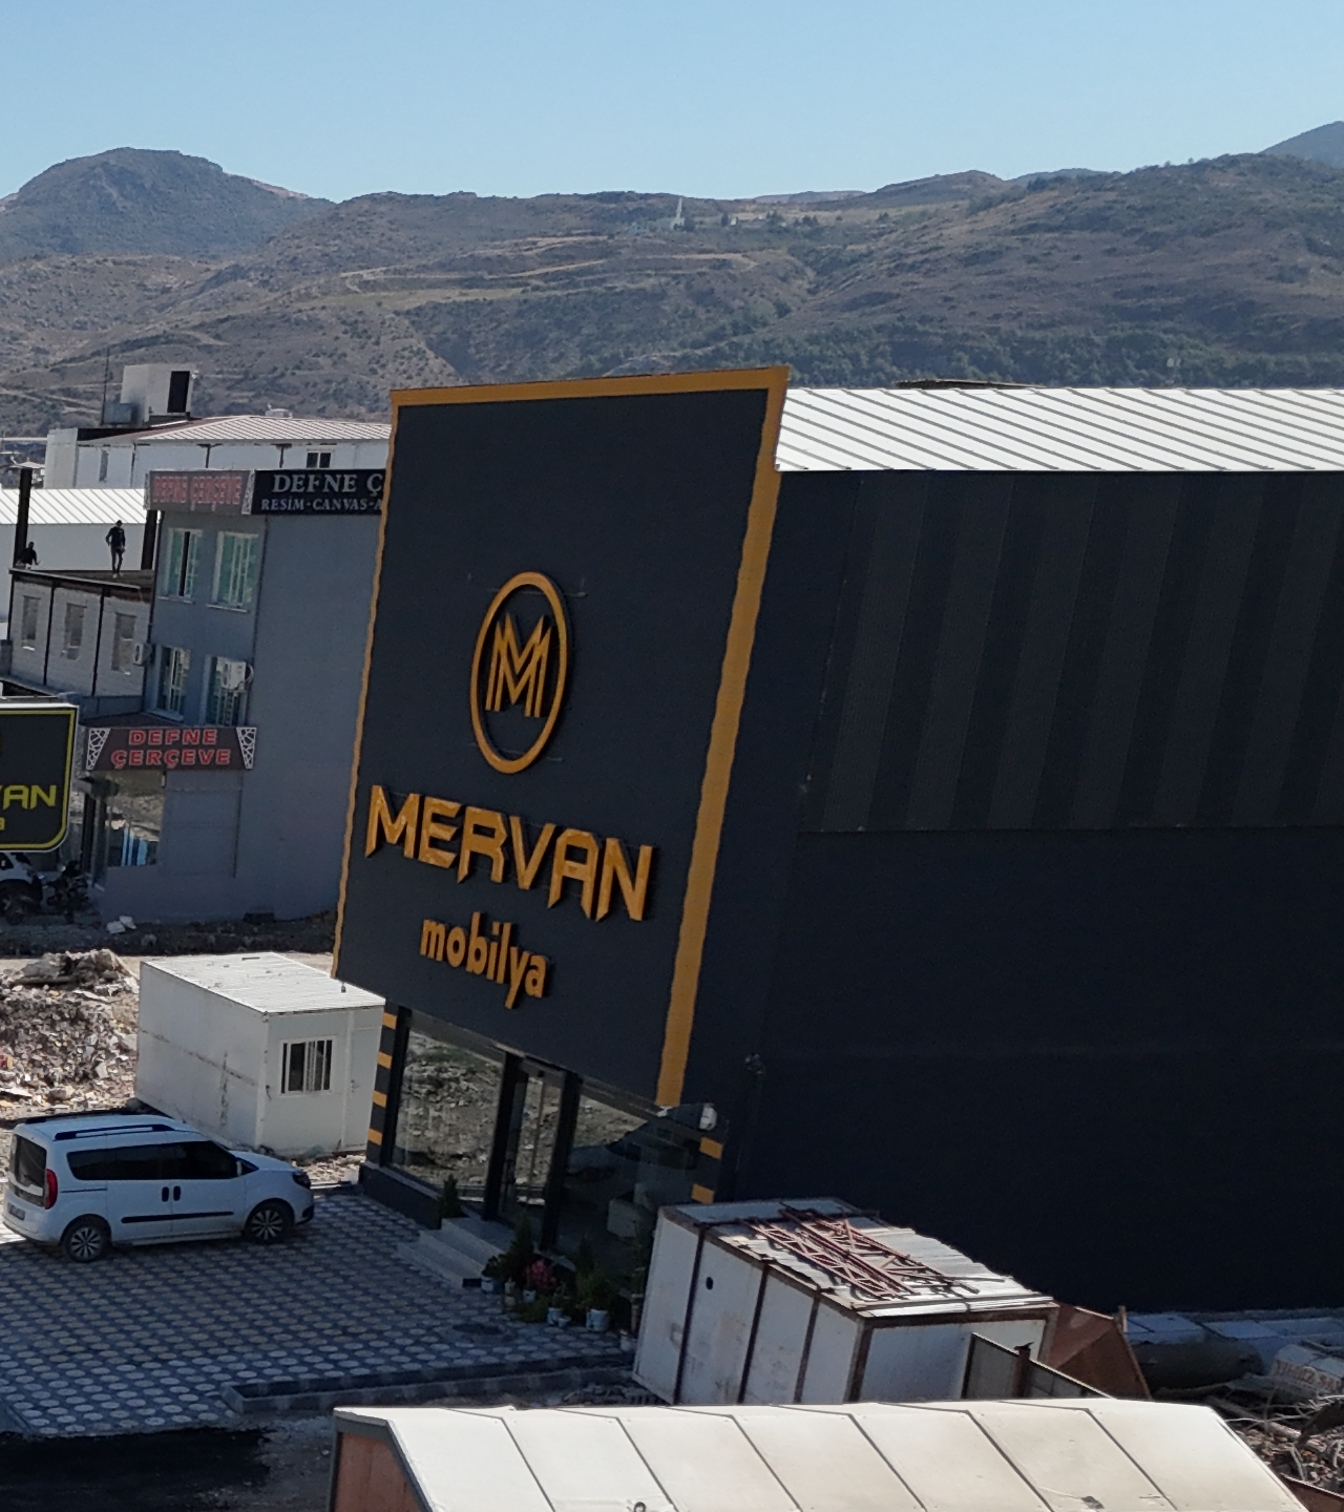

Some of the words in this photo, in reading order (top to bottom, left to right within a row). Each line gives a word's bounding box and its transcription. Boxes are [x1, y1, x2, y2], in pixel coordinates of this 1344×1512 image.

[272, 474, 357, 493] DEFNE
[129, 729, 217, 745] DEFNE
[111, 749, 231, 769] ÇERÇEVE
[365, 784, 654, 923] MERVAN
[420, 912, 549, 1009] mobilya
